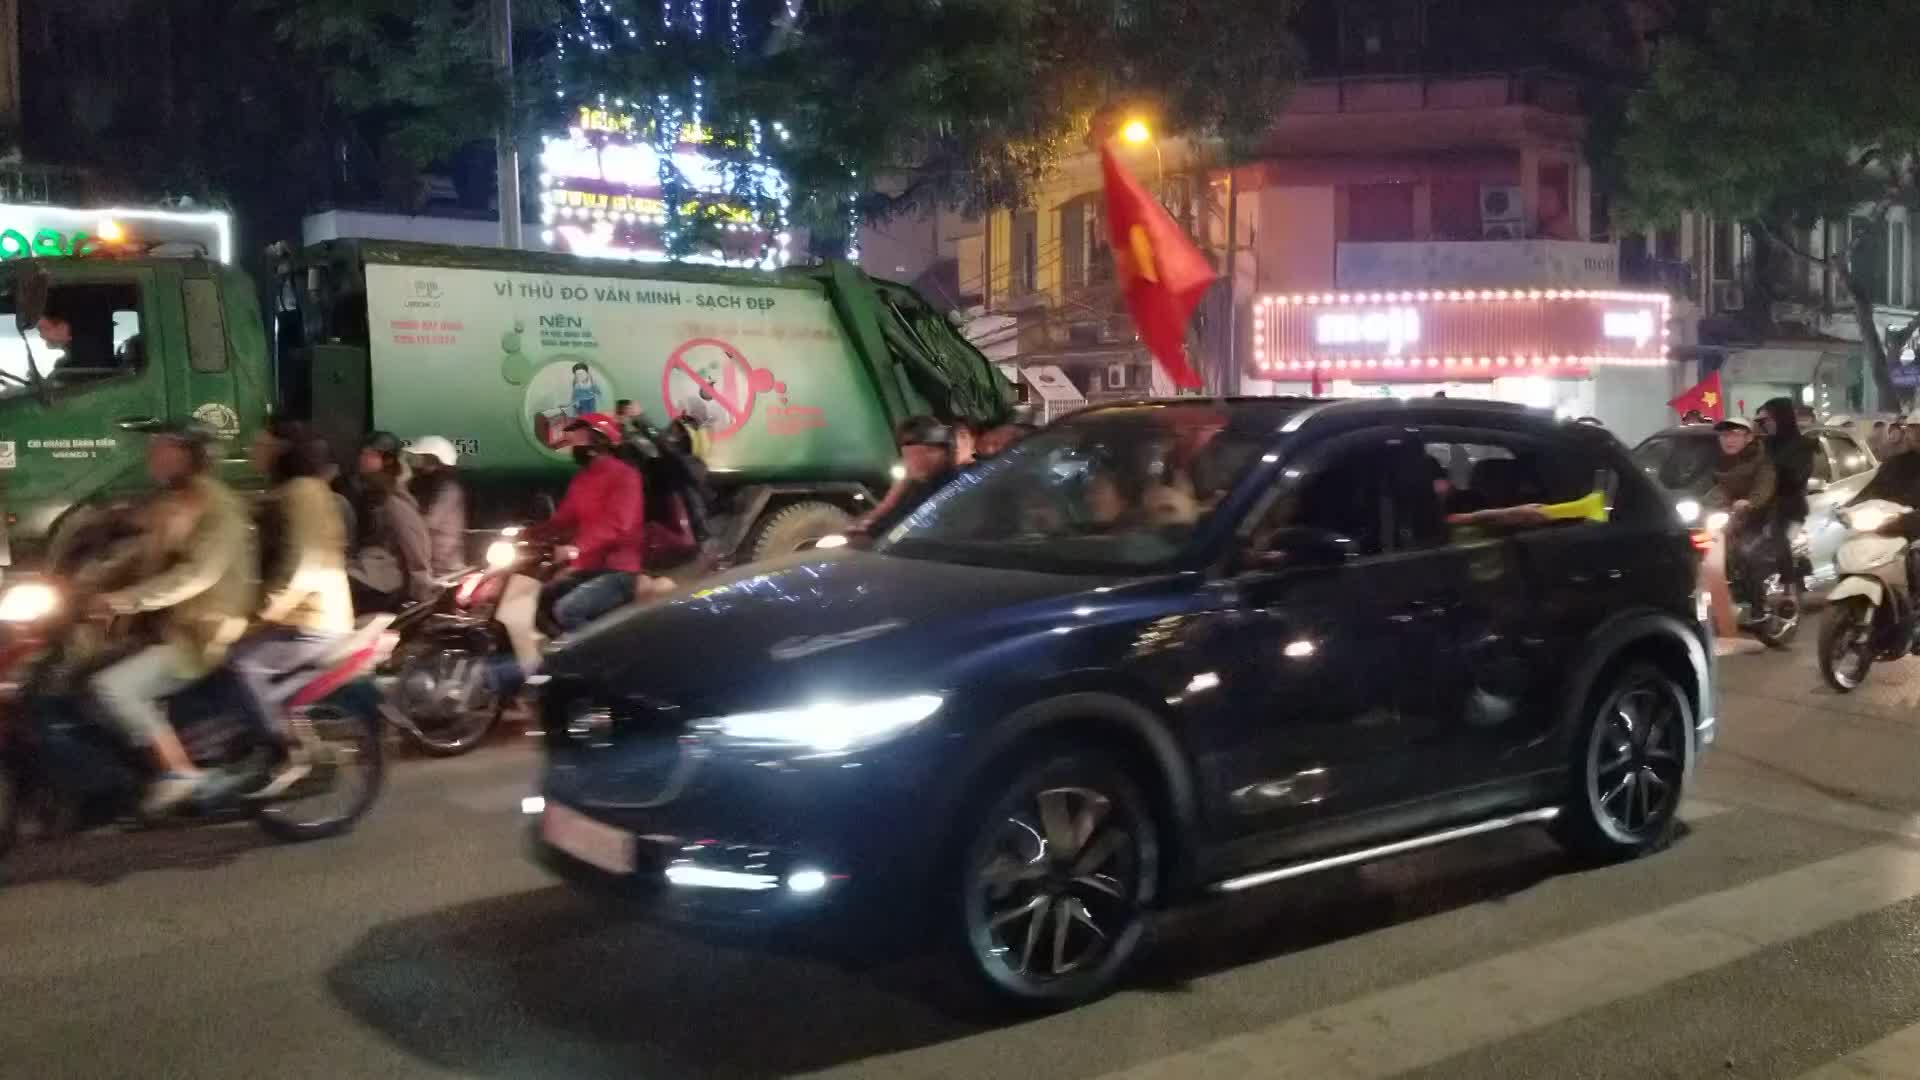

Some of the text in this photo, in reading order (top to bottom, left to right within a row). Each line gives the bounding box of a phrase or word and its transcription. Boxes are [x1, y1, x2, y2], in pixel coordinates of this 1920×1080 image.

[636, 289, 681, 306] MINH
[695, 293, 742, 311] SẠCH
[539, 313, 583, 329] NÊN
